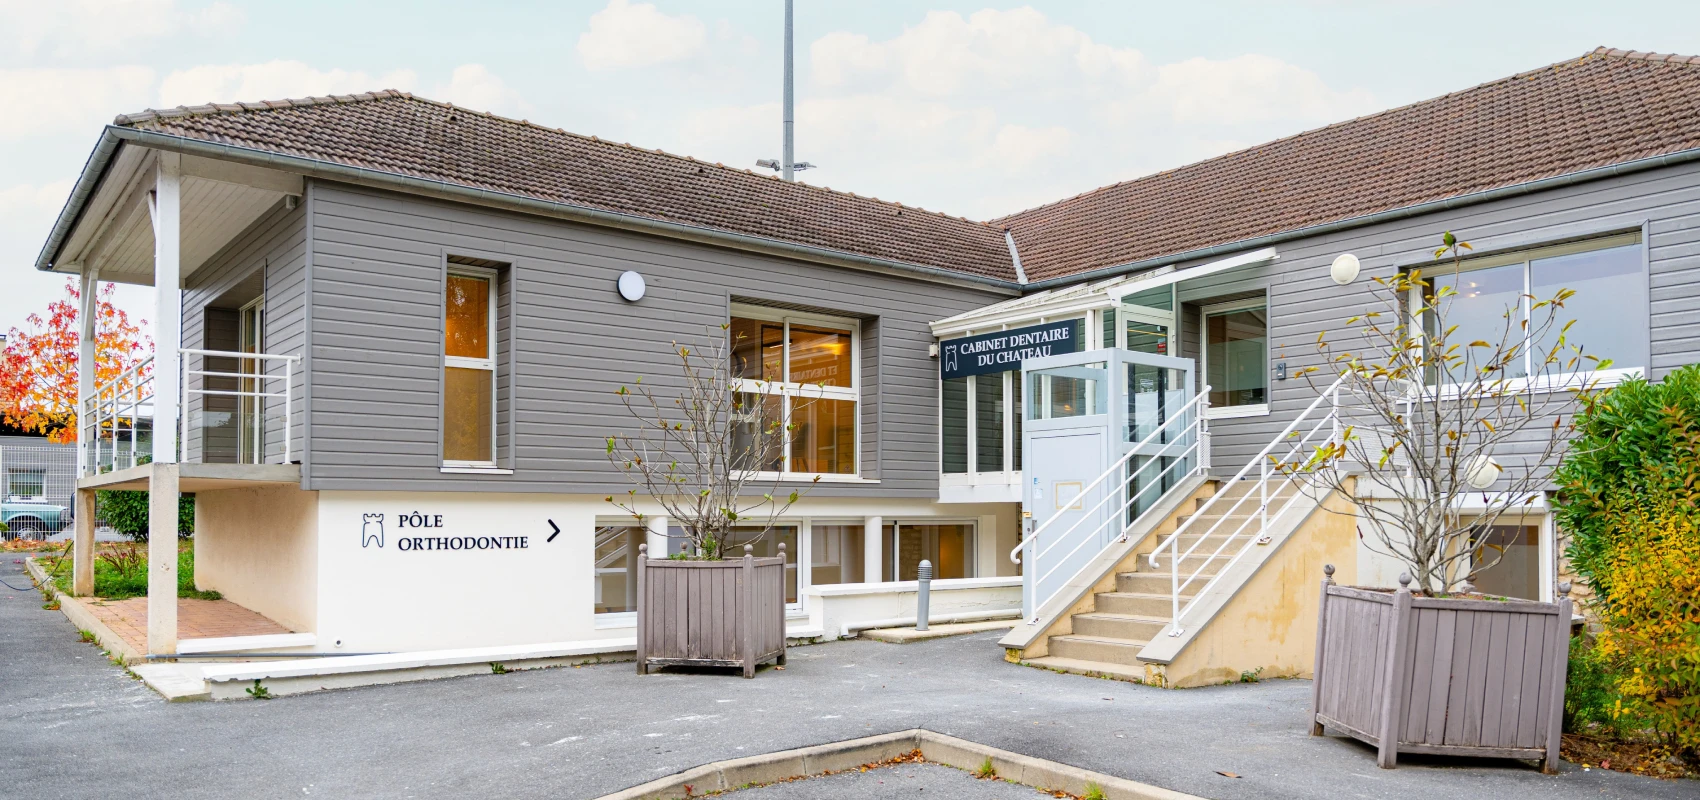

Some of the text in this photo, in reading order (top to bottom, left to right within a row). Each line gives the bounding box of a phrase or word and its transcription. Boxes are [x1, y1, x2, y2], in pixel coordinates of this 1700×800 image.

[960, 327, 1070, 355] CABINET DENTAIRE
[977, 345, 1052, 367] DU CHATEAU
[398, 510, 444, 528] PÔLE
[398, 536, 529, 551] ORTHODONTIE
